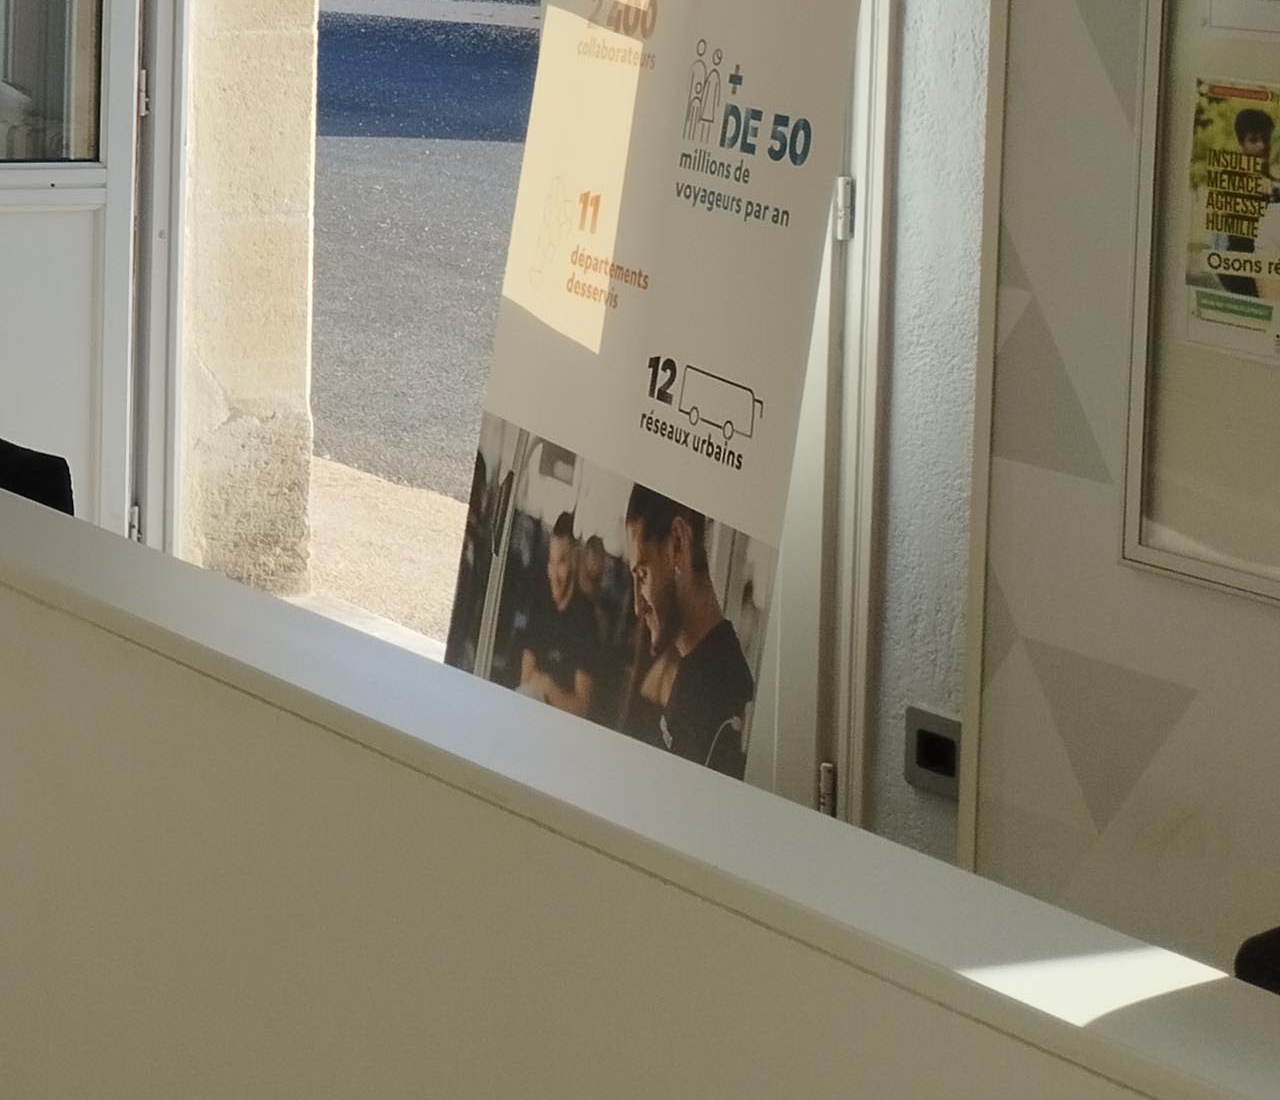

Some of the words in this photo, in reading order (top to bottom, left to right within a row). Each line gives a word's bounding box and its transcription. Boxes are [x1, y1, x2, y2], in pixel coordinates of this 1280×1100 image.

[576, 36, 656, 70] collaborateurs
[719, 103, 763, 156] DE
[768, 114, 812, 166] 50
[679, 148, 731, 180] millions
[734, 159, 750, 184] de
[579, 190, 602, 234] 11
[676, 182, 742, 214] voyageurs
[744, 200, 769, 222] par
[771, 207, 790, 227] an
[570, 244, 649, 290] départements
[1207, 252, 1262, 274] Osons
[566, 271, 618, 309] desservis
[648, 356, 677, 405] 12
[640, 409, 690, 447] réseaux
[692, 433, 743, 470] urbains
